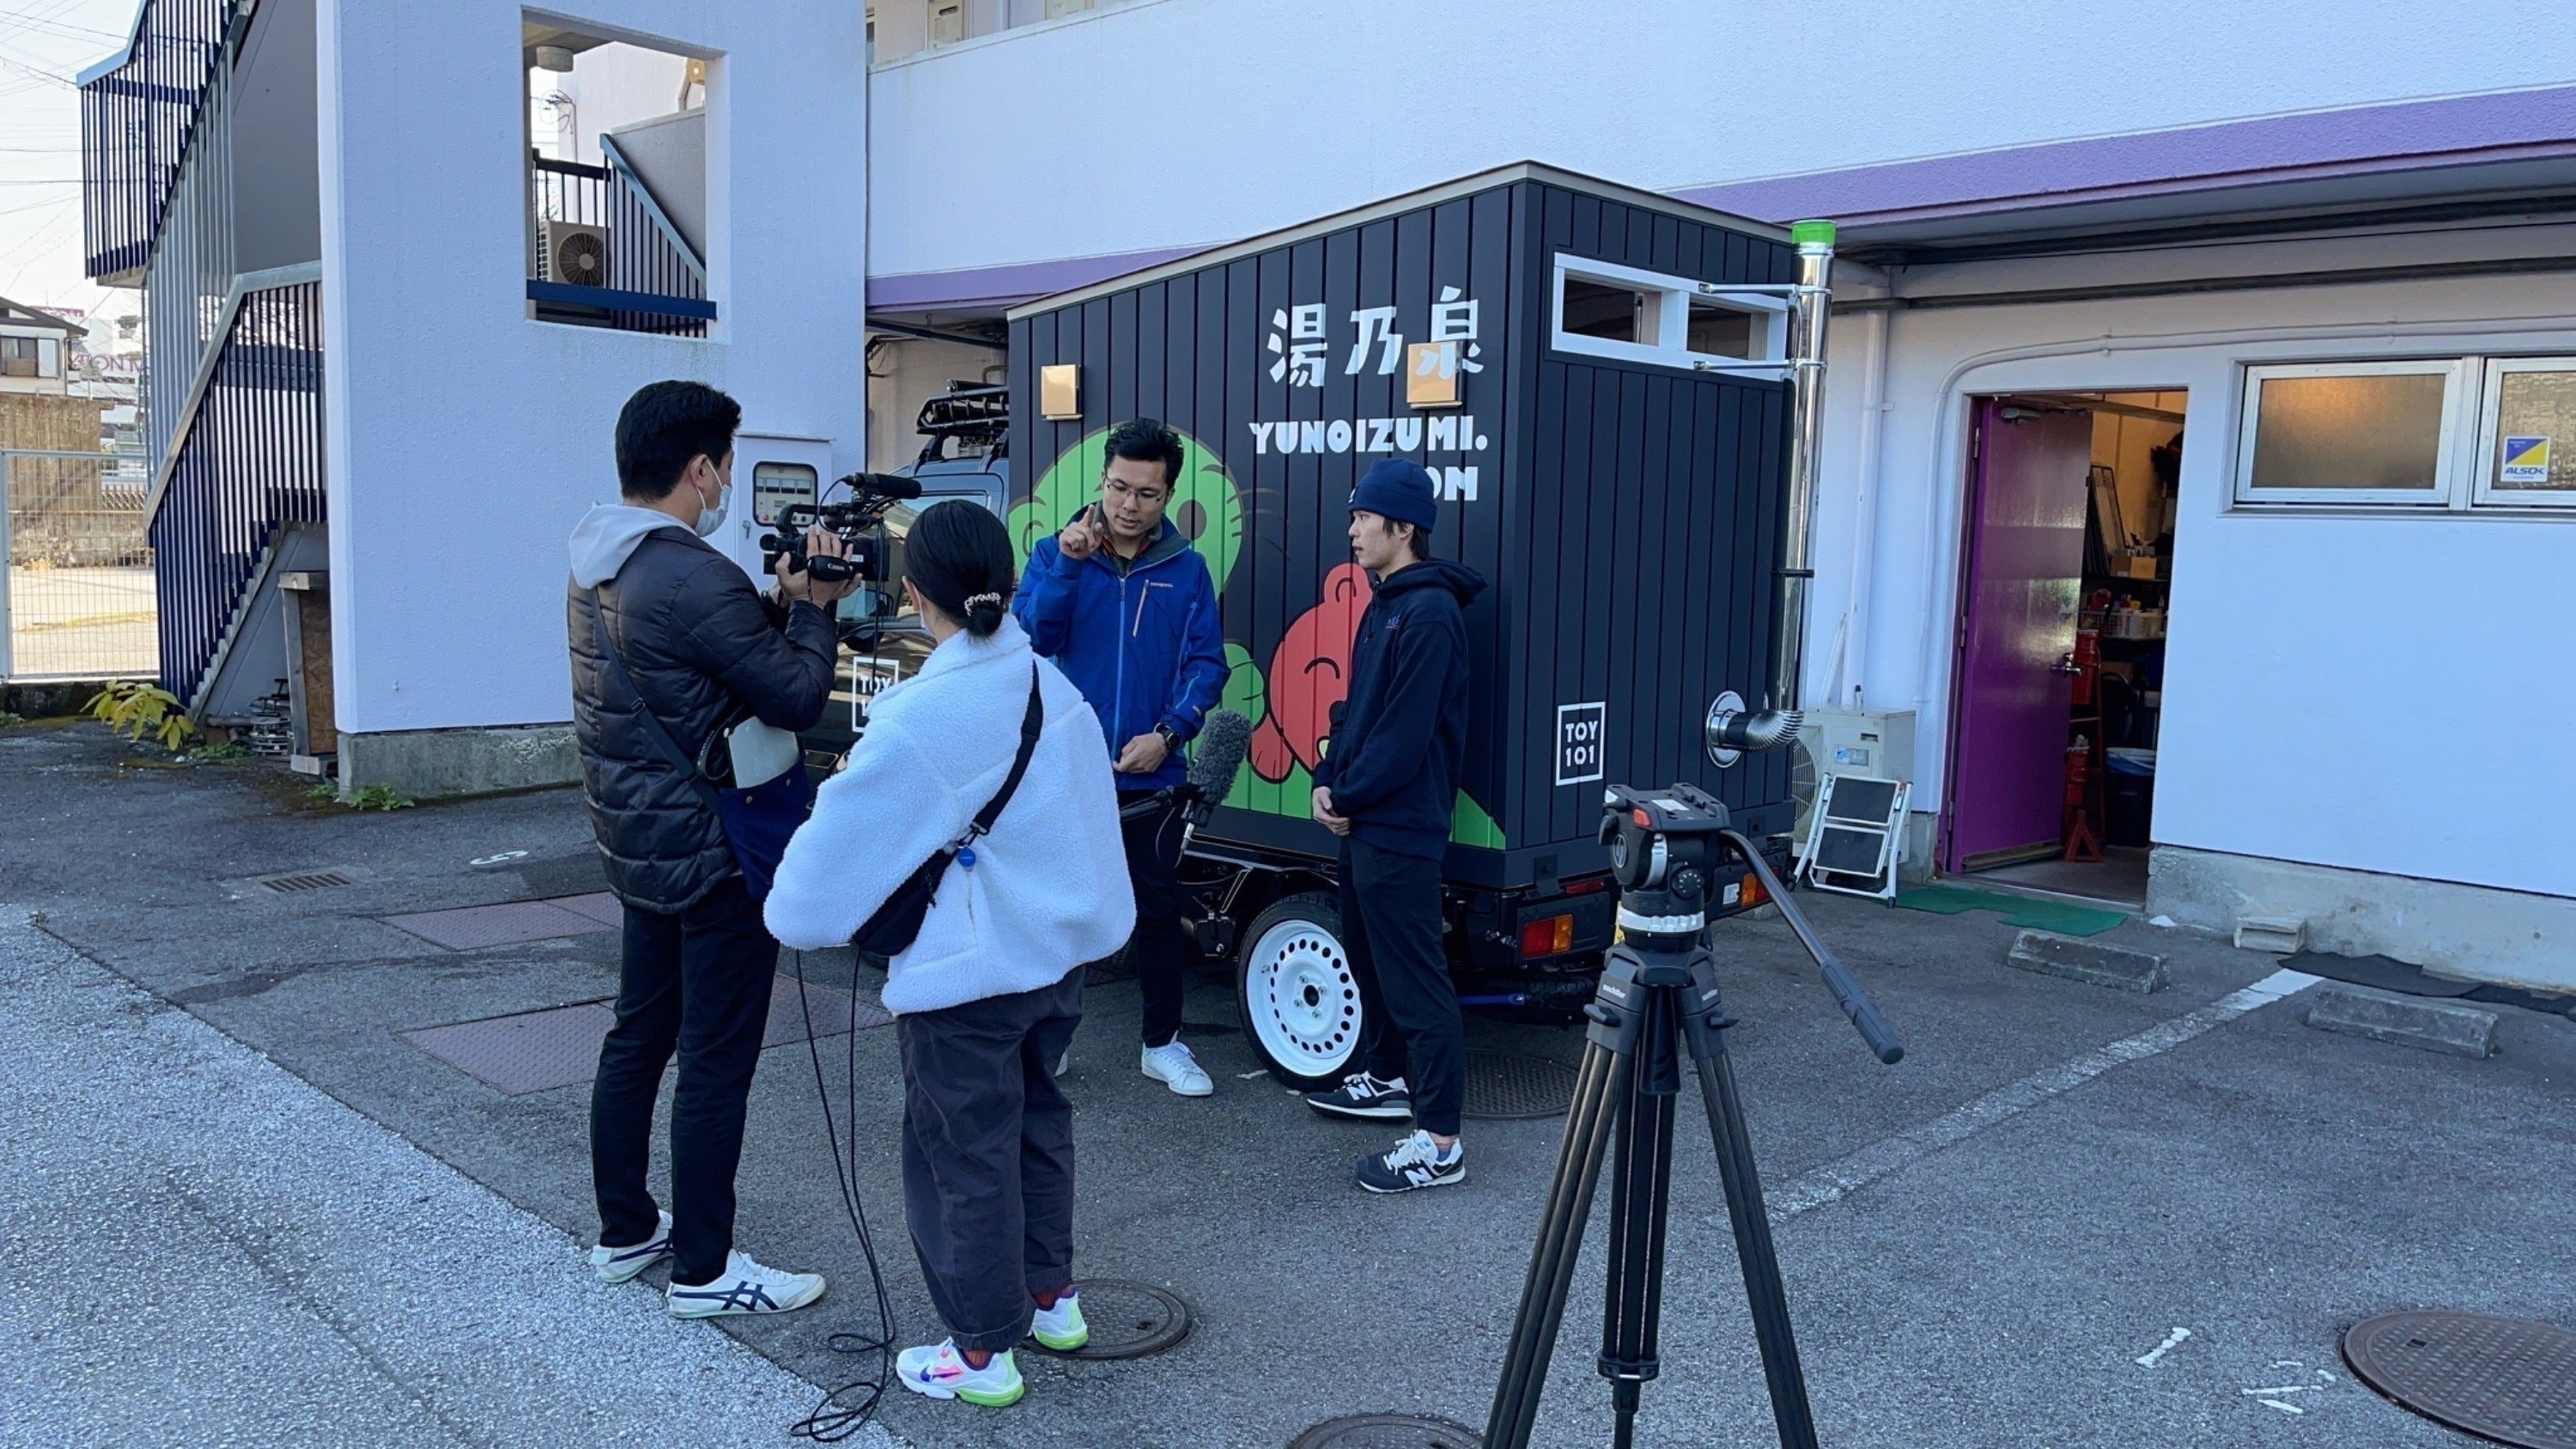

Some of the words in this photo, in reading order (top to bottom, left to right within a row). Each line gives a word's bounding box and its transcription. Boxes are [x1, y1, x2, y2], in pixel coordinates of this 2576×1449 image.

[1267, 285, 1485, 387] 湯乃泉
[1248, 415, 1489, 454] YUNOIZUMI.
[1565, 720, 1598, 743] TOY
[1565, 744, 1595, 767] 101
[1346, 1082, 1372, 1101] N
[1404, 1166, 1434, 1187] N
